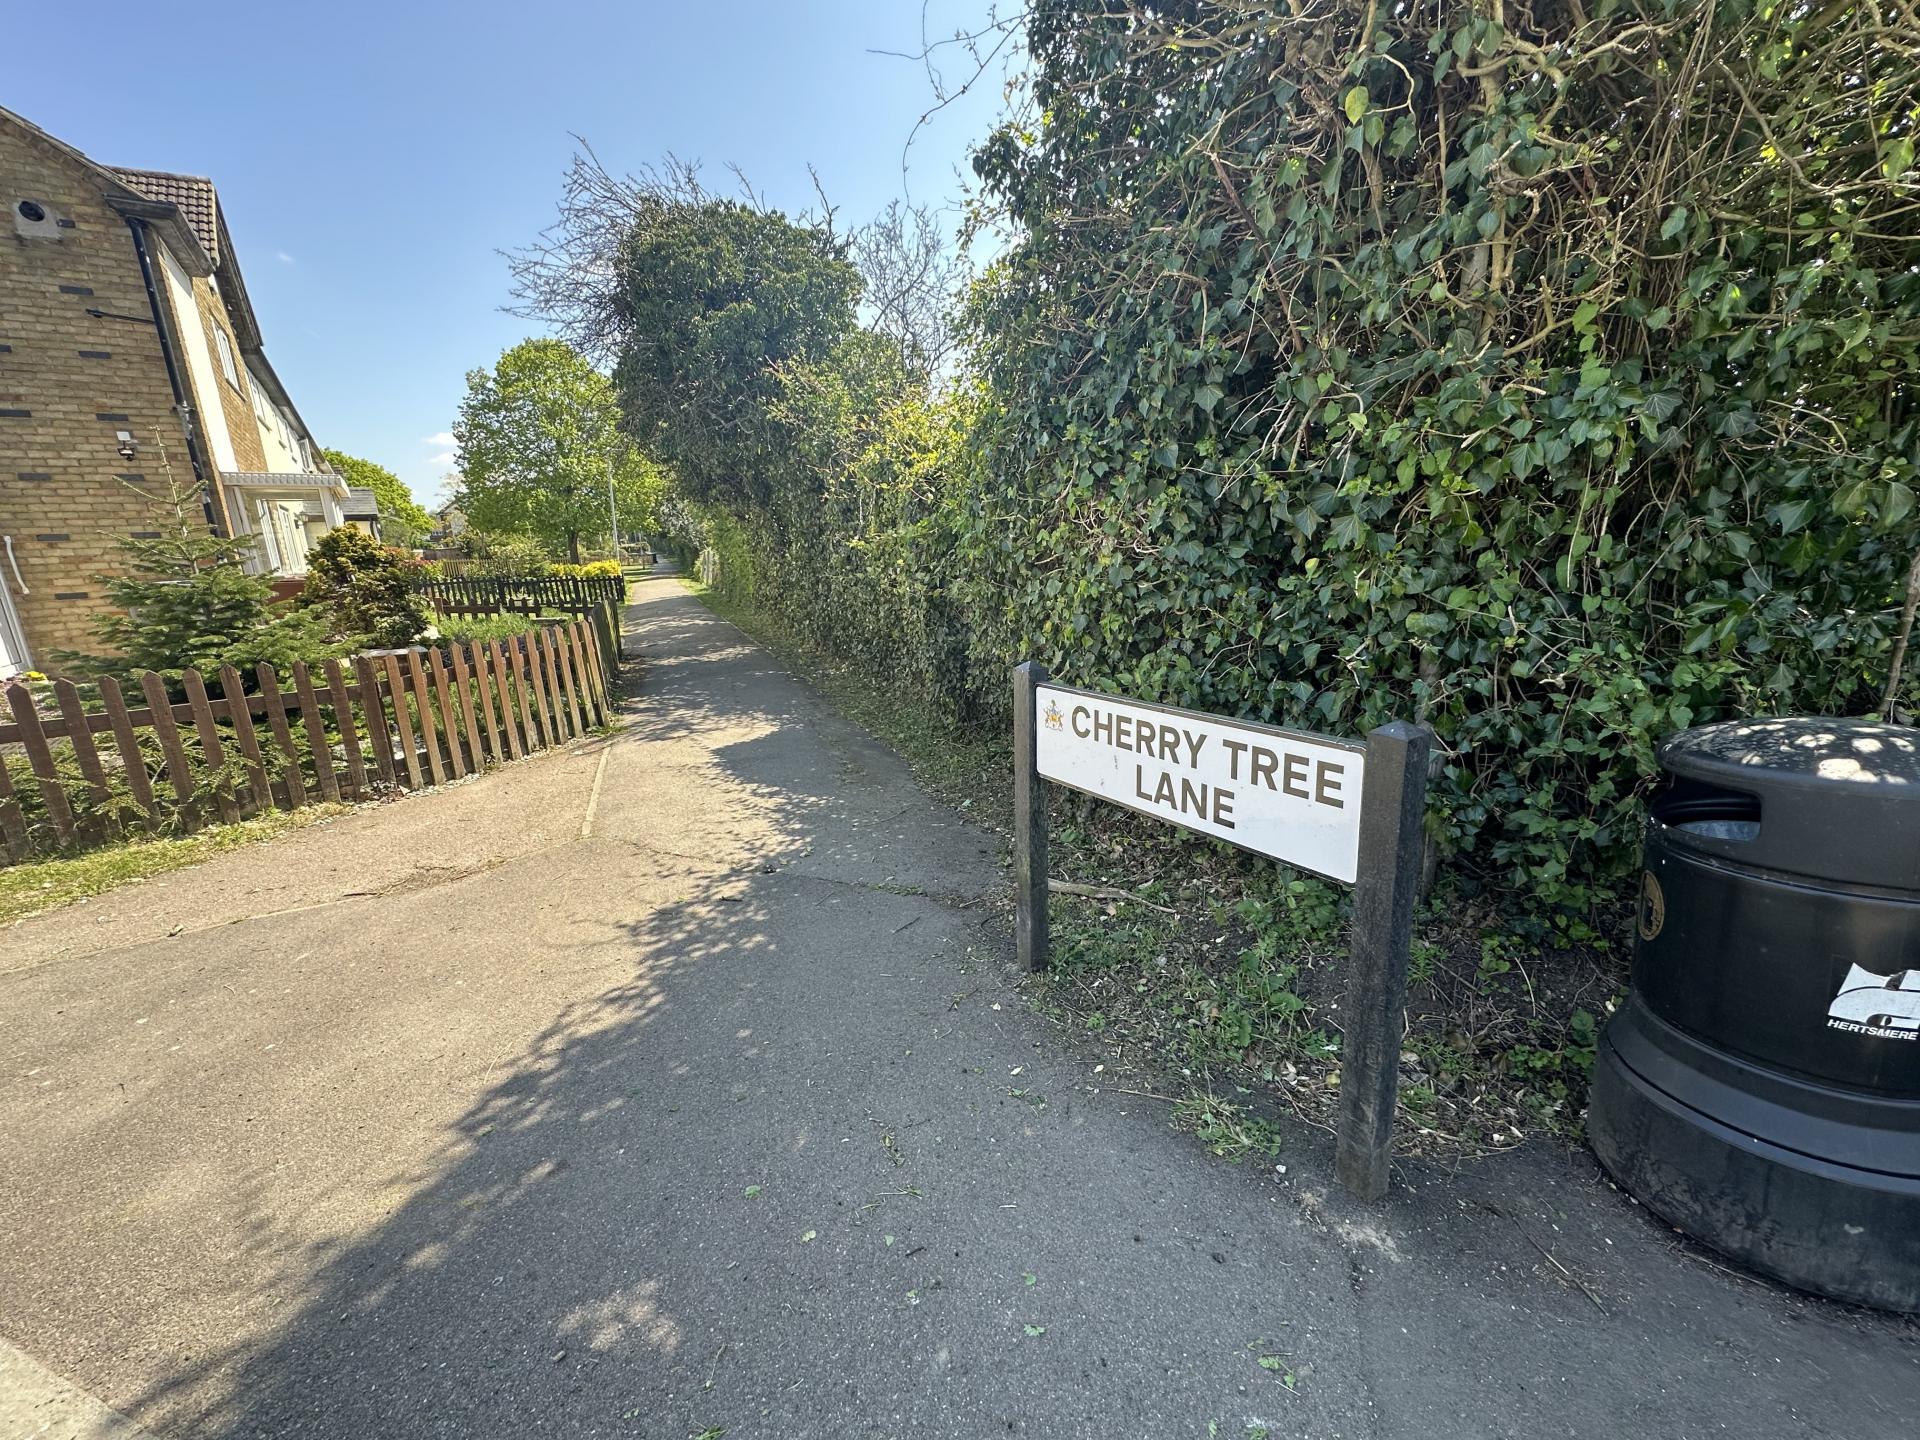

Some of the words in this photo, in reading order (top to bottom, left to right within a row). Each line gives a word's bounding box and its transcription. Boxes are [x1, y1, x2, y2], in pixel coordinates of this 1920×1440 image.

[1071, 705, 1208, 769] CHERRY
[1222, 738, 1345, 809] TREE
[1136, 765, 1235, 829] LANE
[1828, 1019, 1918, 1040] HERTSMERE
